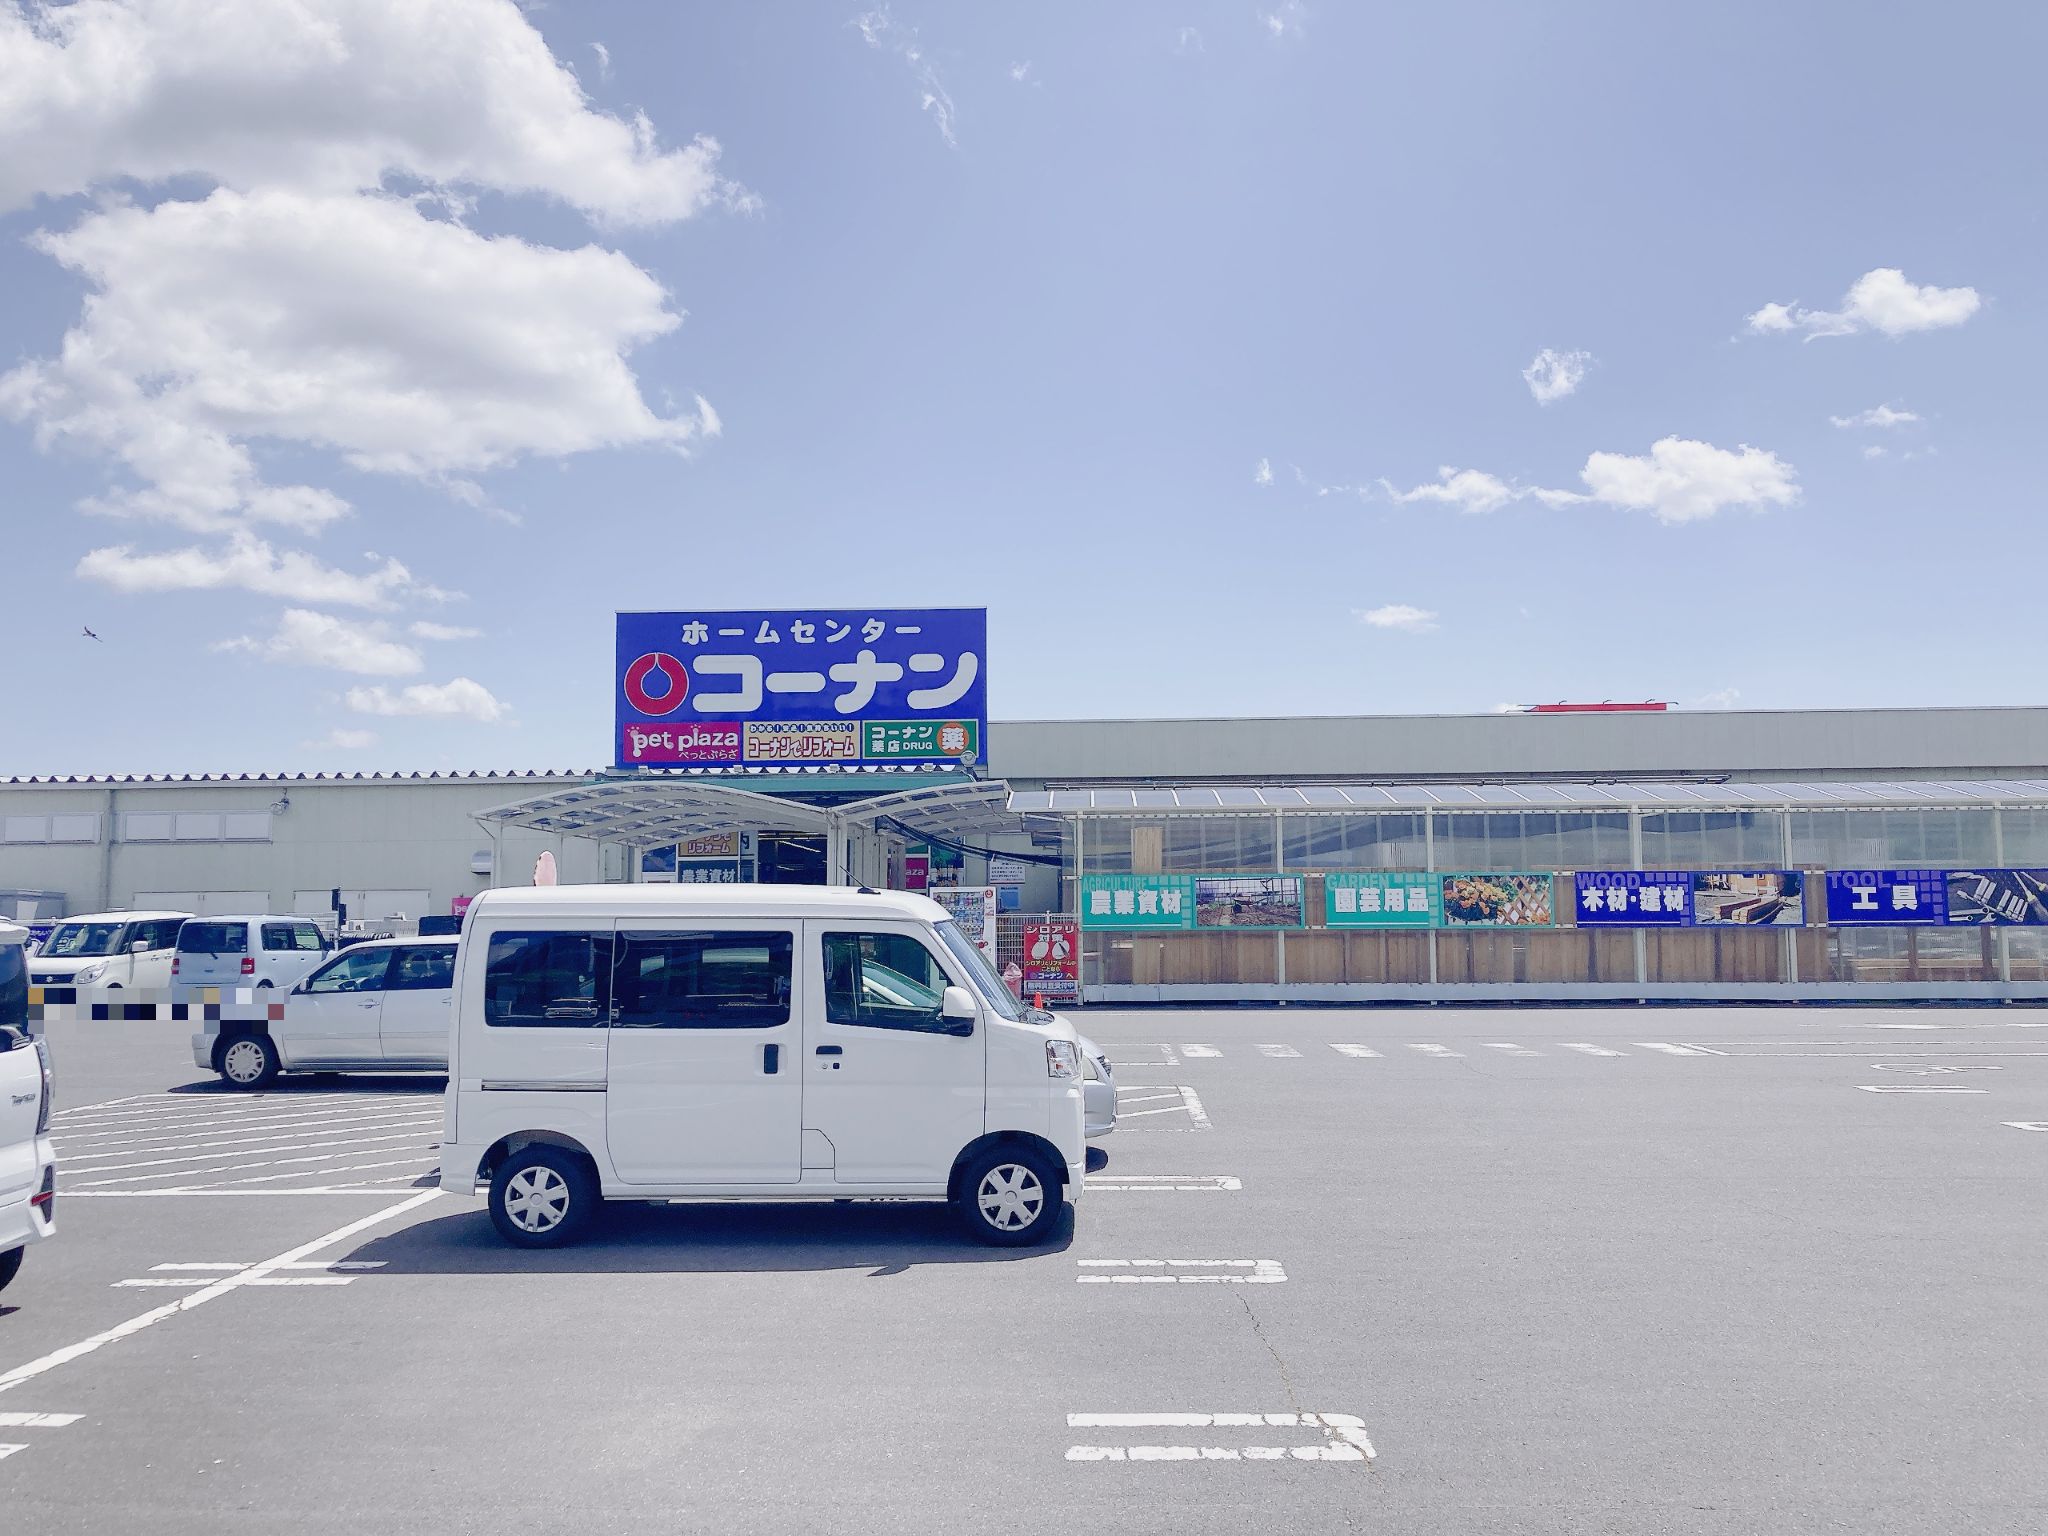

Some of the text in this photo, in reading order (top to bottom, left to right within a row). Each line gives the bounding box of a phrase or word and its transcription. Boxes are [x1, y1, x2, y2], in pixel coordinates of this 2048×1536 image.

[681, 617, 922, 646] ホームセンター
[692, 649, 979, 714] コーナン
[871, 726, 933, 739] コーナン
[942, 727, 965, 750] 薬
[630, 727, 738, 757] pet plaza
[748, 736, 855, 758] コーナンでリフォーム
[871, 740, 933, 753] 薬店 DRUG
[679, 749, 738, 760] ぺっとぷらざ
[687, 842, 730, 853] リフォーム
[682, 868, 736, 883] 農業資材
[1326, 874, 1390, 891] GARDEN
[1577, 873, 1641, 889] WOOD
[1827, 872, 1891, 888] TOOL
[1083, 876, 1147, 893] AGRICULTURE
[1091, 889, 1182, 915] 農業資材
[1335, 887, 1429, 912] 園芸用品
[1852, 885, 1918, 911] 工具
[1026, 925, 1075, 934] シロアリ
